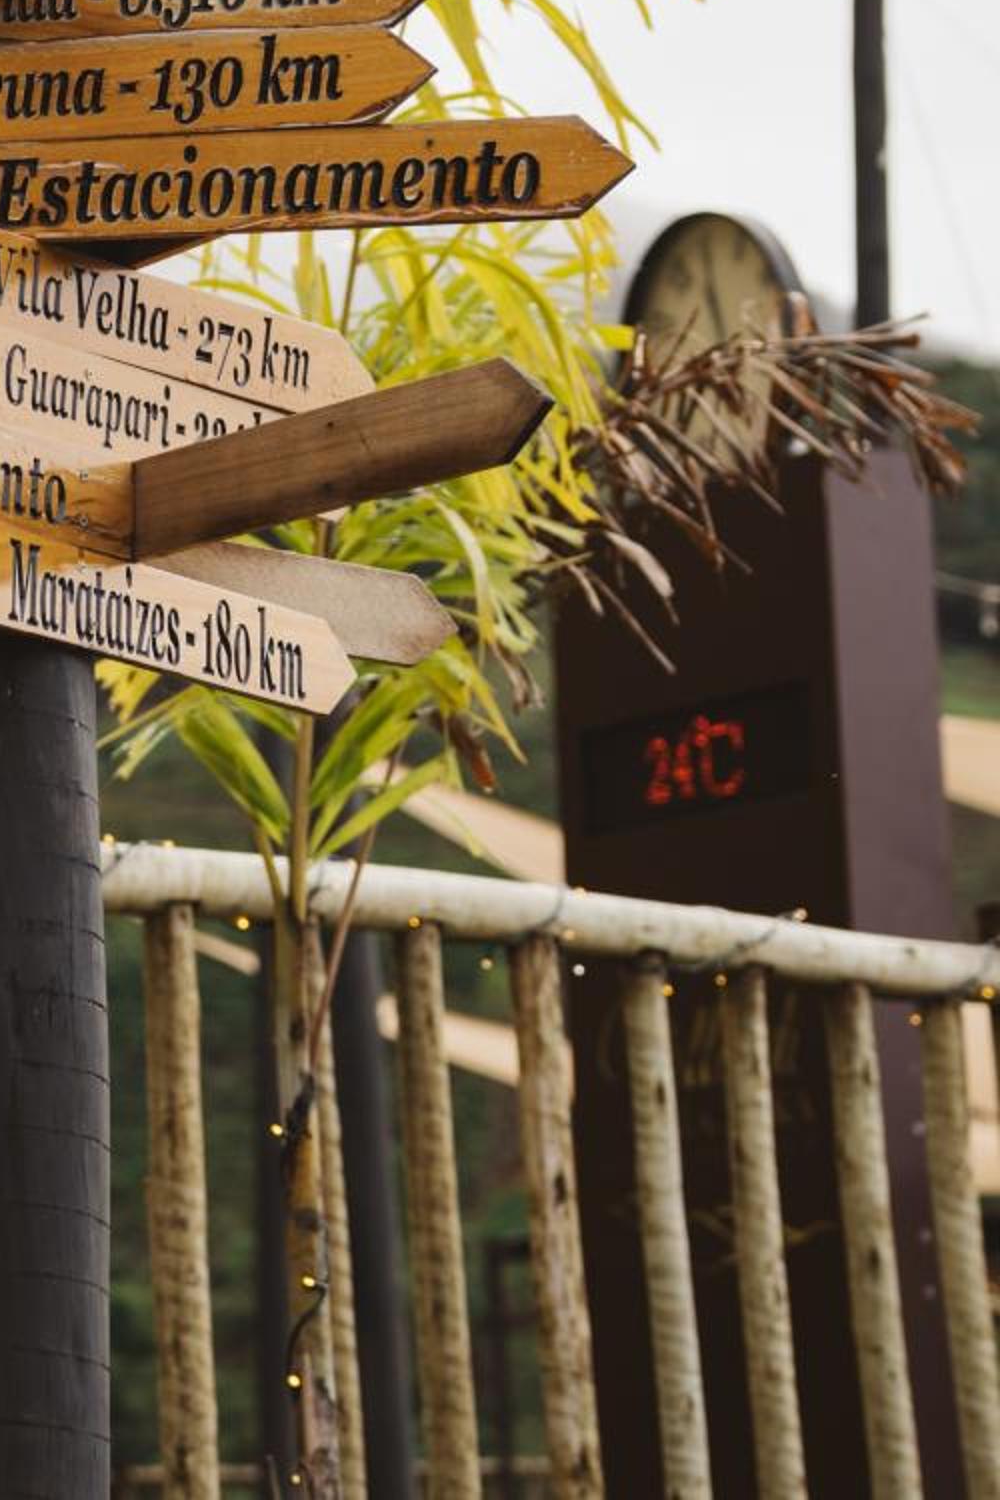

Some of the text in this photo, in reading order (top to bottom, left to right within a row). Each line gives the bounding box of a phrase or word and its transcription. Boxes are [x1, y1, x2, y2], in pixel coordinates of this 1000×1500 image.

[150, 56, 243, 125] 130
[256, 34, 342, 104] km
[72, 266, 169, 351] Velha
[195, 316, 253, 387] 273
[261, 317, 310, 392] km
[5, 343, 170, 448] Guarapari
[202, 599, 251, 684] 180
[257, 605, 307, 700] km
